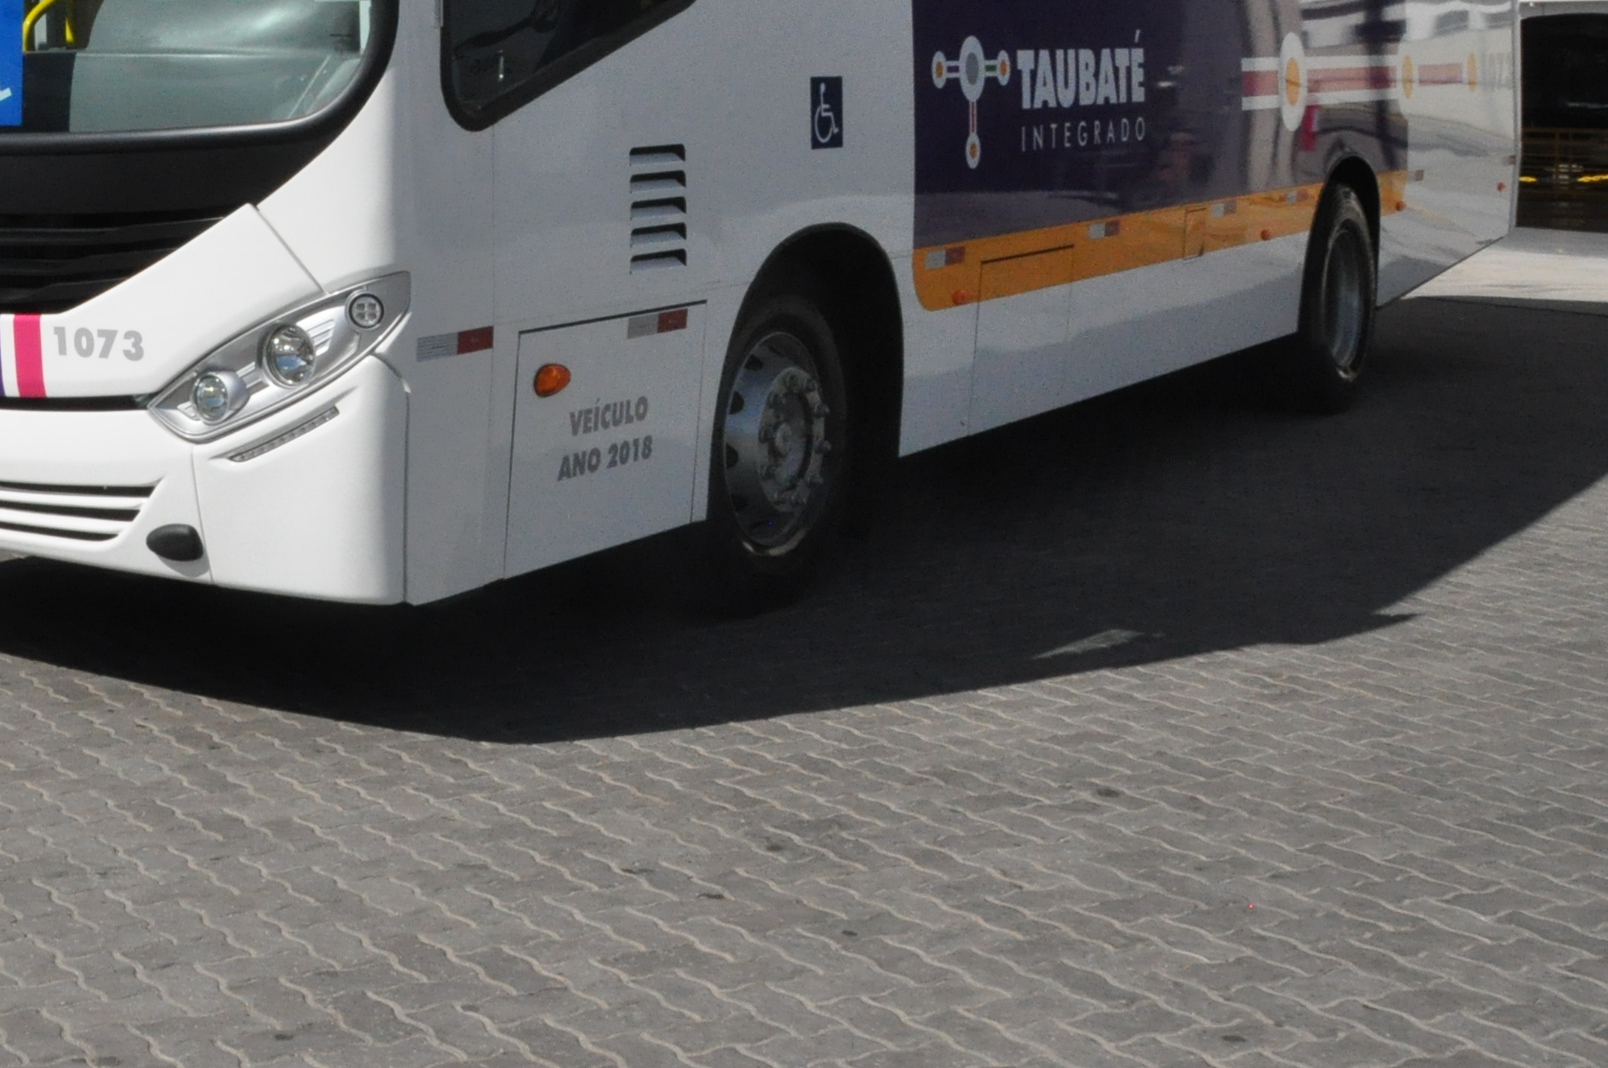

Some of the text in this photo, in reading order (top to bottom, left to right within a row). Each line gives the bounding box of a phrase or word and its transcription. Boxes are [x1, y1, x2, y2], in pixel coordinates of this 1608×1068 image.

[1016, 29, 1146, 110] TAUBATÉ
[1021, 117, 1145, 152] INTEGRADO
[52, 325, 144, 362] 1073
[570, 395, 649, 436] VEÍCULO
[557, 435, 653, 482] ANO 2018
